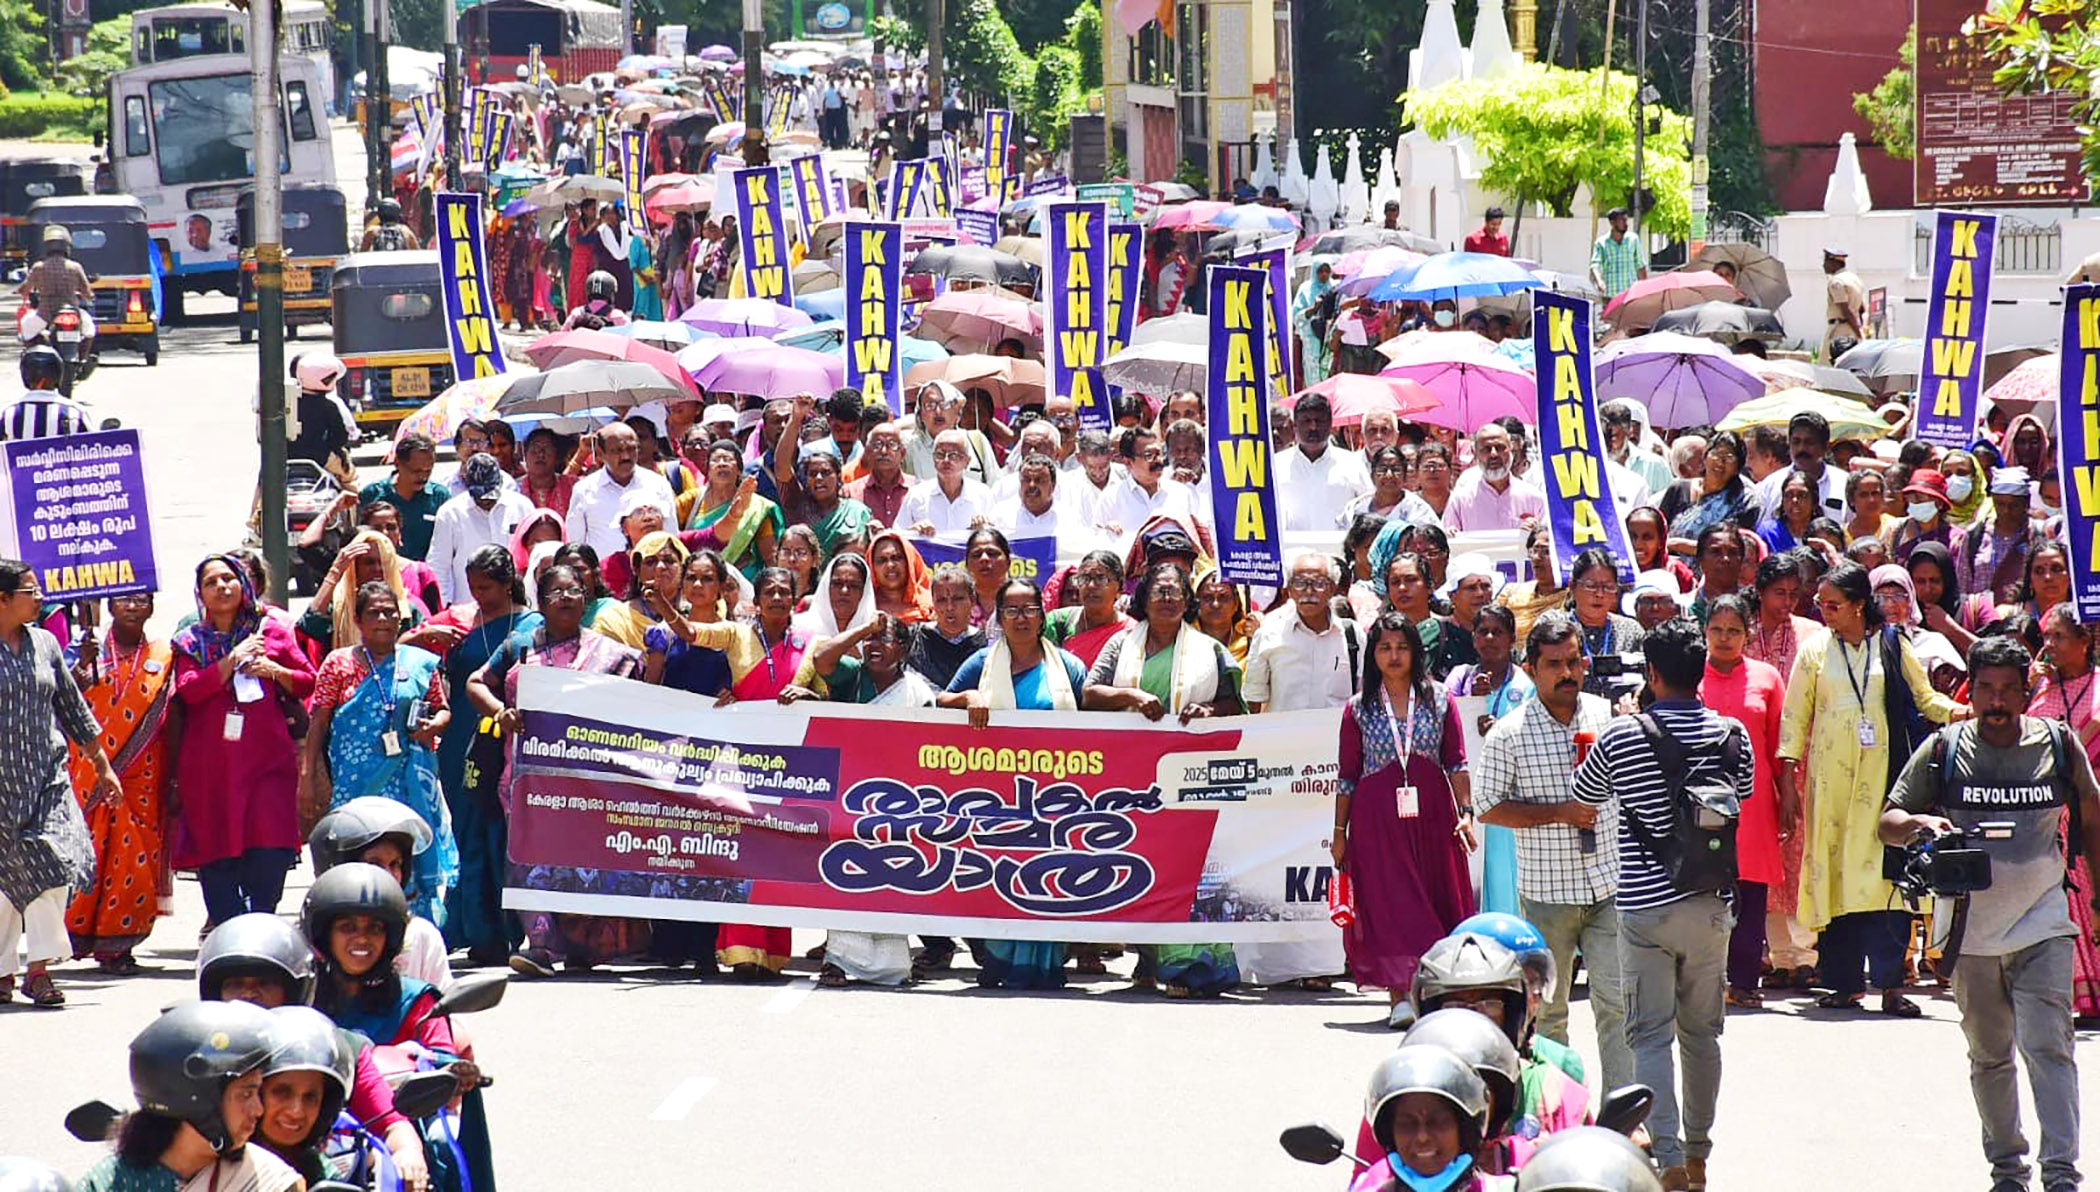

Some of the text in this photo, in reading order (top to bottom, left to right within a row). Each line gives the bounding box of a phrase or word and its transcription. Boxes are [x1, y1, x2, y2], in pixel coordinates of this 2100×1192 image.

[746, 174, 784, 301] KAHW
[853, 229, 892, 408] KAHWA
[1060, 211, 1097, 407] KAHWA
[1932, 220, 1980, 418] KAHWA
[1218, 280, 1267, 541] KAHWA
[1548, 306, 1608, 546] KAHWA
[33, 462, 120, 484] മരണപ്പെടുന്ന
[33, 494, 129, 520] കുടുംബത്തിന്
[36, 480, 122, 502] ആശമാരുടെ
[29, 515, 137, 542] 10 ലക്ഷം രൂപ
[44, 560, 135, 593] KAHWA
[566, 725, 666, 754] ഓണറേറിയം
[522, 736, 611, 763] വിരമിക്കൽ
[715, 768, 831, 793] പ്രഖ്യാപിക്കുക
[918, 744, 1104, 780] ആശമാരുടെ
[1183, 767, 1208, 781] 2025
[1210, 761, 1246, 781] മേയ്
[1247, 764, 1256, 779] 5
[568, 796, 604, 811] ആശാ
[1962, 785, 2054, 804] REVOLUTION
[605, 831, 739, 861] എം.എ. ബിന്ദു
[818, 840, 1156, 916] യാത്ര
